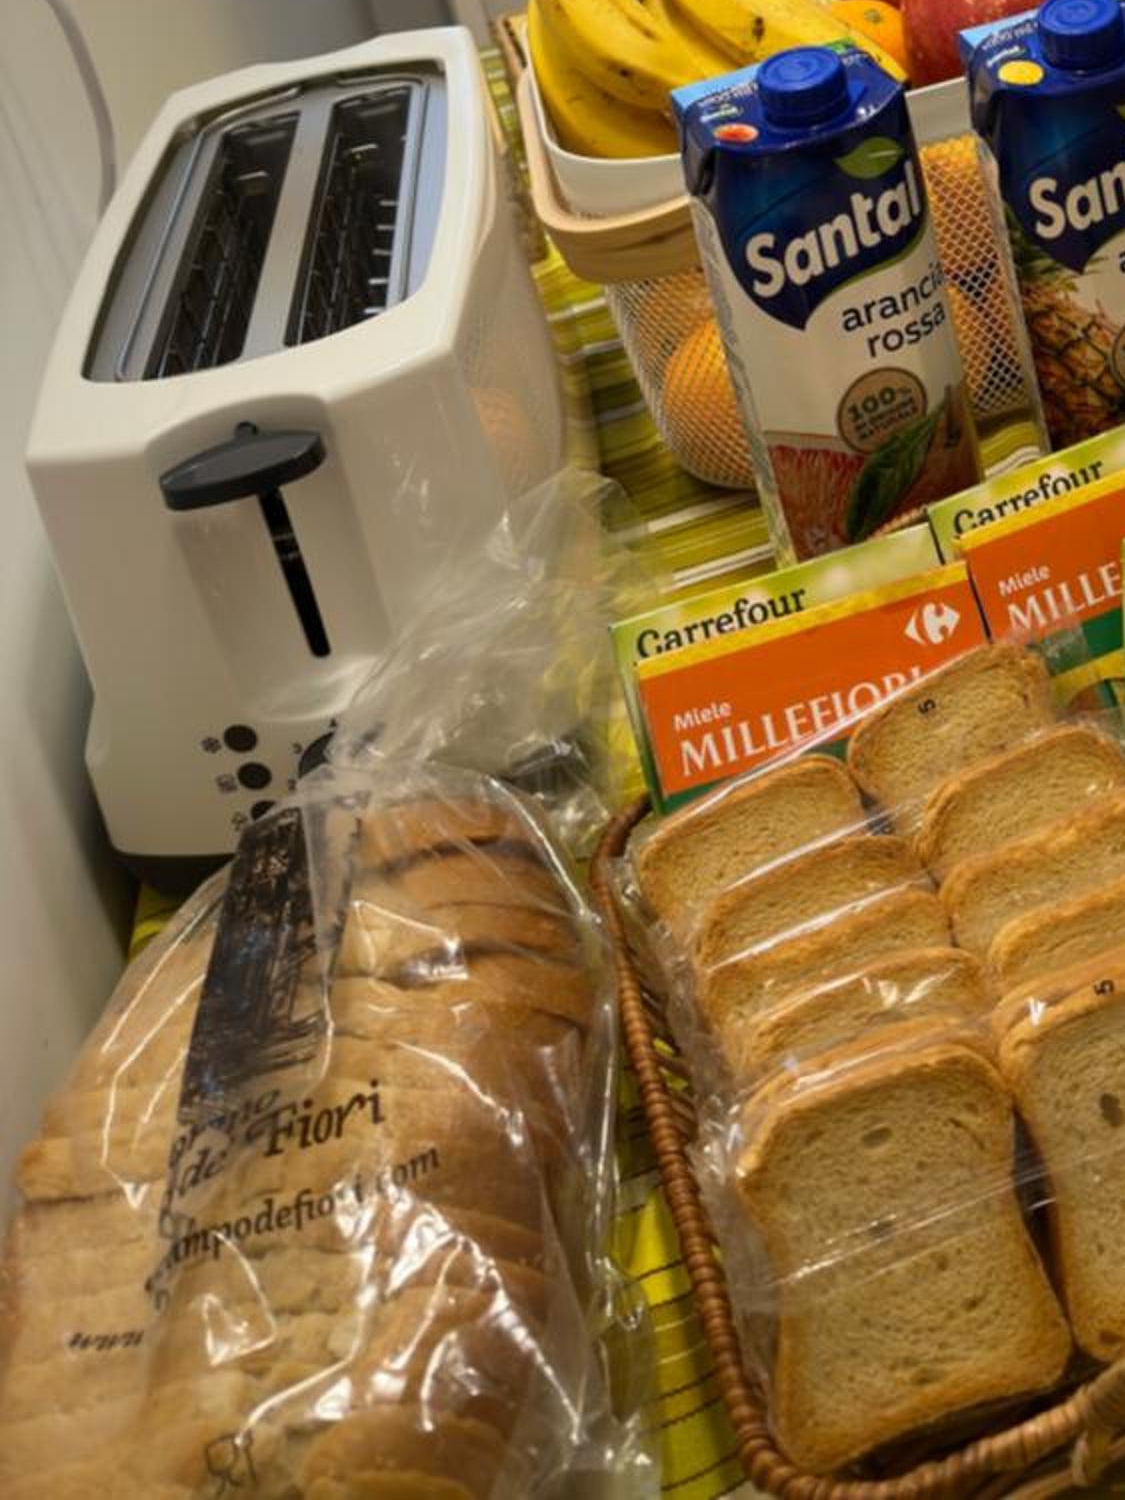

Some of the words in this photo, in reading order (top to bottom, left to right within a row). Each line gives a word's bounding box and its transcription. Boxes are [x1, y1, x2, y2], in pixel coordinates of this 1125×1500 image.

[745, 161, 921, 299] Santal
[867, 301, 946, 358] rossa
[952, 460, 1104, 540] Carrefour
[999, 563, 1052, 597] Miele
[636, 587, 807, 660] Carrefour
[673, 700, 733, 732] Miele
[246, 1079, 385, 1157] Fiori
